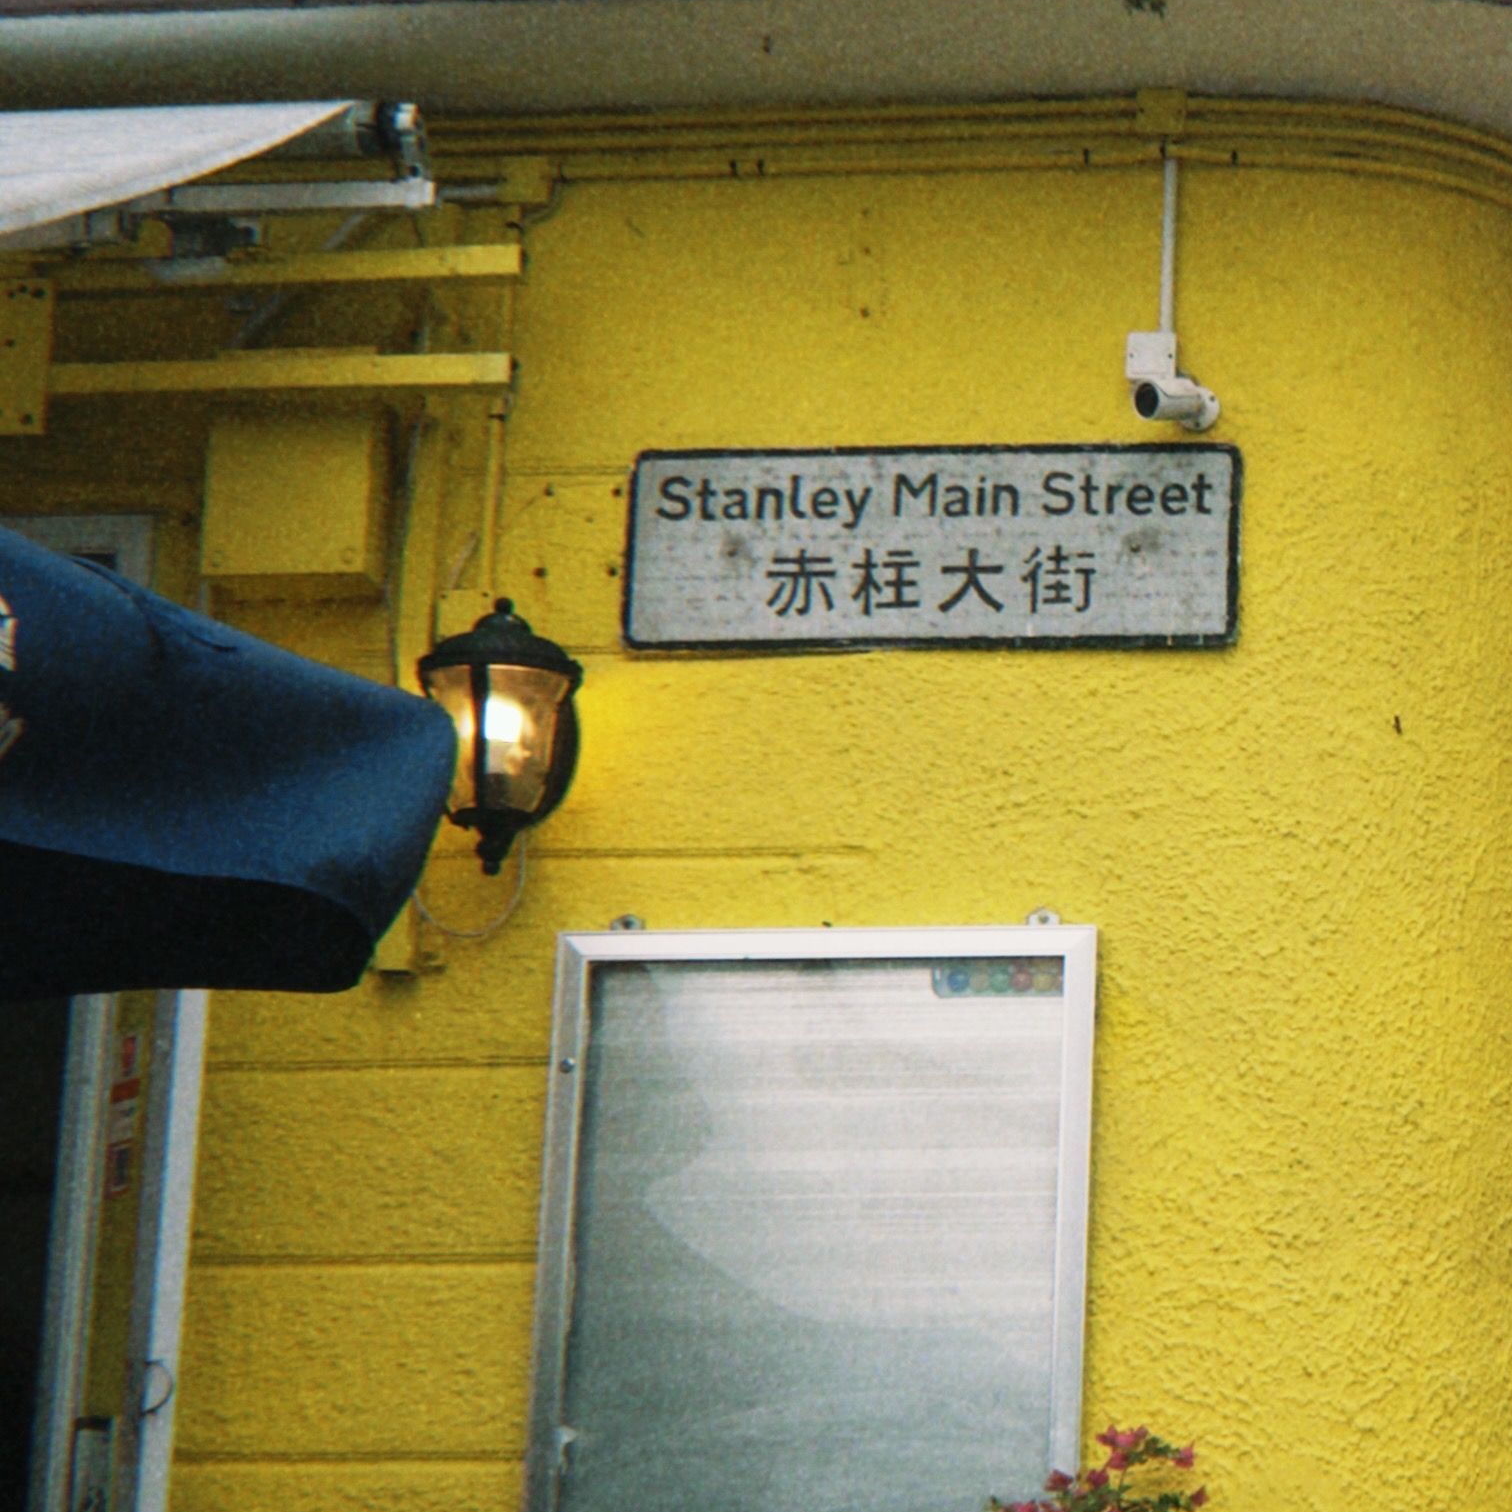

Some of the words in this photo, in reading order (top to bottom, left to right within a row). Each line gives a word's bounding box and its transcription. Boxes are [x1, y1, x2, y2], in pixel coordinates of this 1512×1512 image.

[656, 474, 872, 529] Stanley
[893, 473, 1019, 517] Main
[1042, 471, 1213, 516] Street
[766, 544, 1097, 616] 赤柱大街
